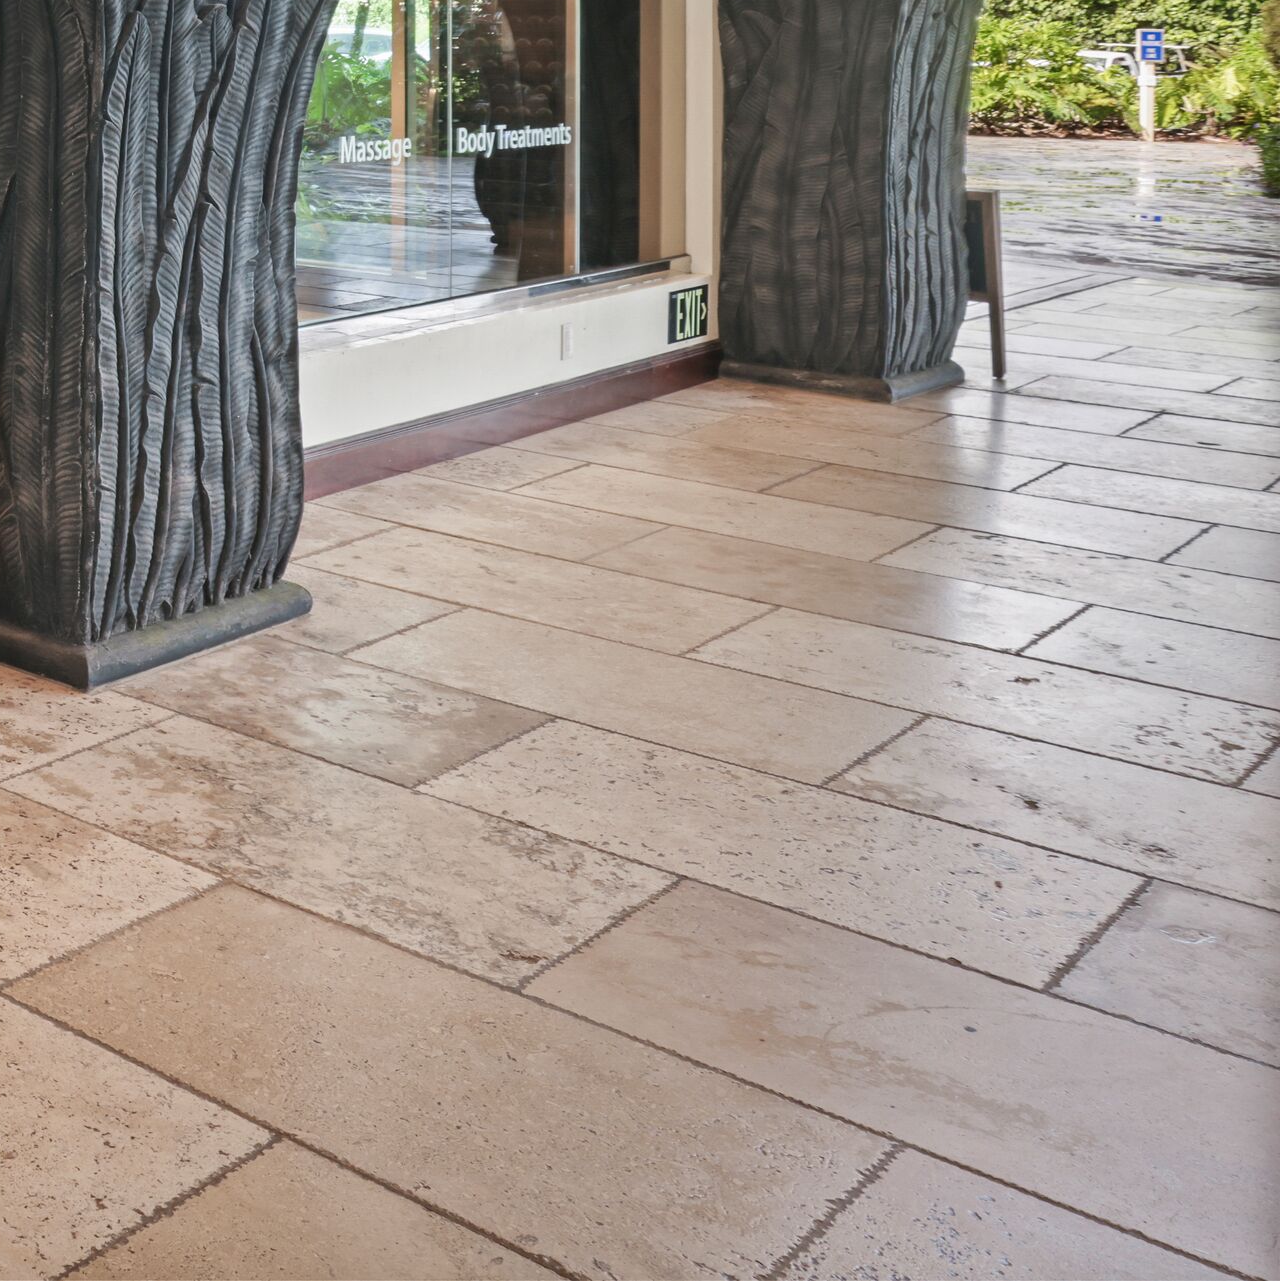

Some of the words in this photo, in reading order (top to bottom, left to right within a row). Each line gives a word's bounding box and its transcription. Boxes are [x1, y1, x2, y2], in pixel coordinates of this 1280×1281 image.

[340, 136, 412, 166] Massage
[456, 124, 495, 159] Body
[495, 123, 572, 151] Treatments
[676, 288, 703, 340] EXIT
